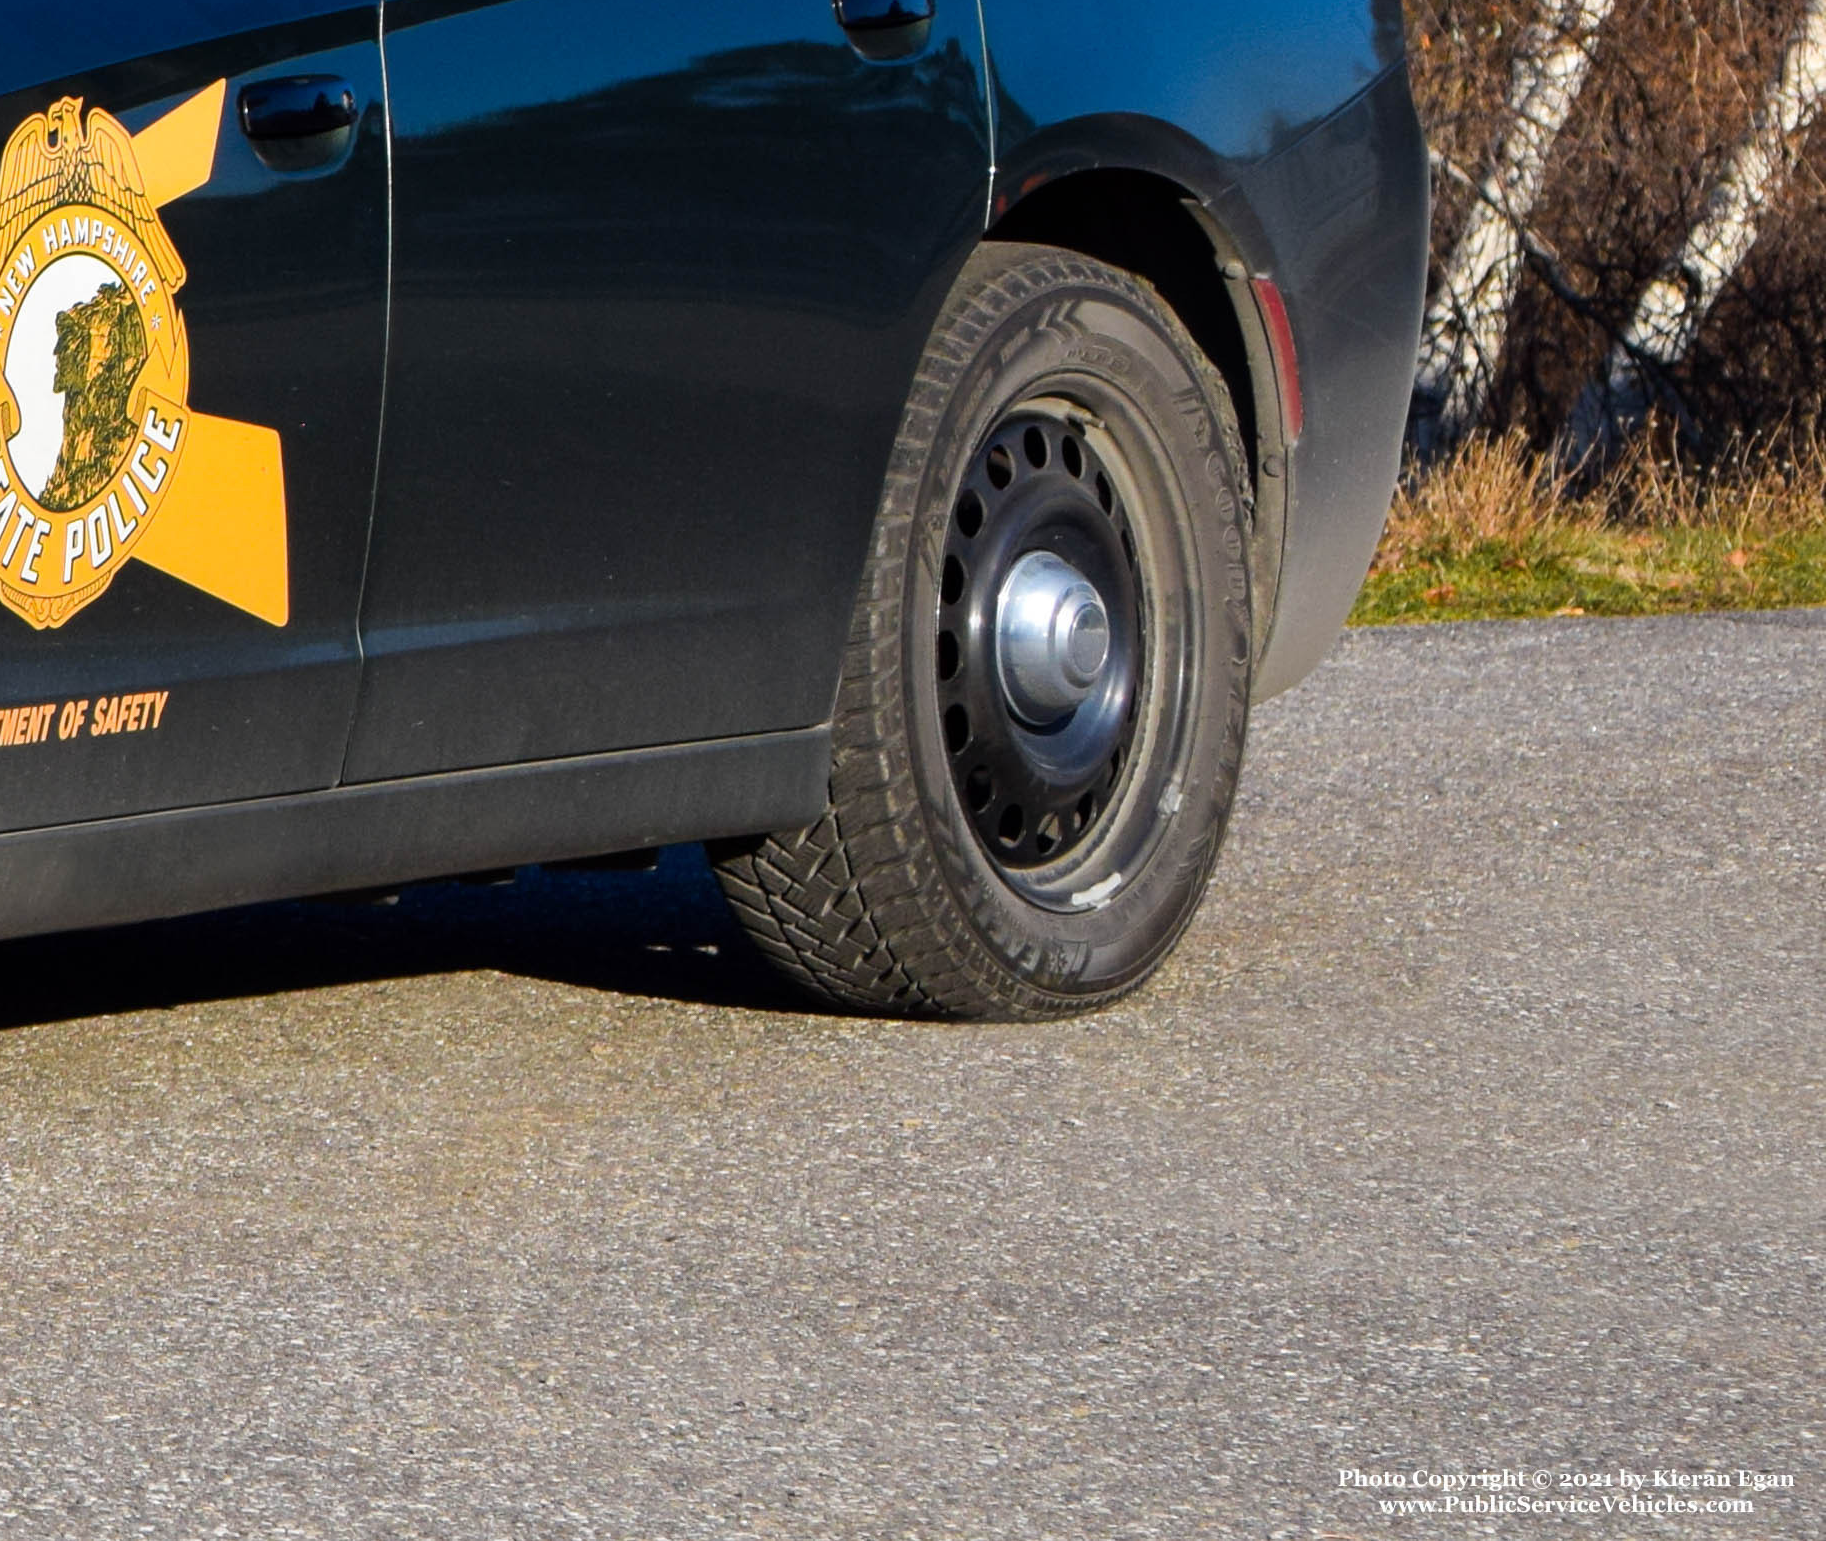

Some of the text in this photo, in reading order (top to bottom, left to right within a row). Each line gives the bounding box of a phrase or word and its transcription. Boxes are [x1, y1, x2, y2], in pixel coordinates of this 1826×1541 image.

[41, 216, 158, 307] HAMPSHIRE
[62, 406, 184, 585] POLICE
[59, 701, 87, 741] OF
[89, 690, 169, 738] SAFETY
